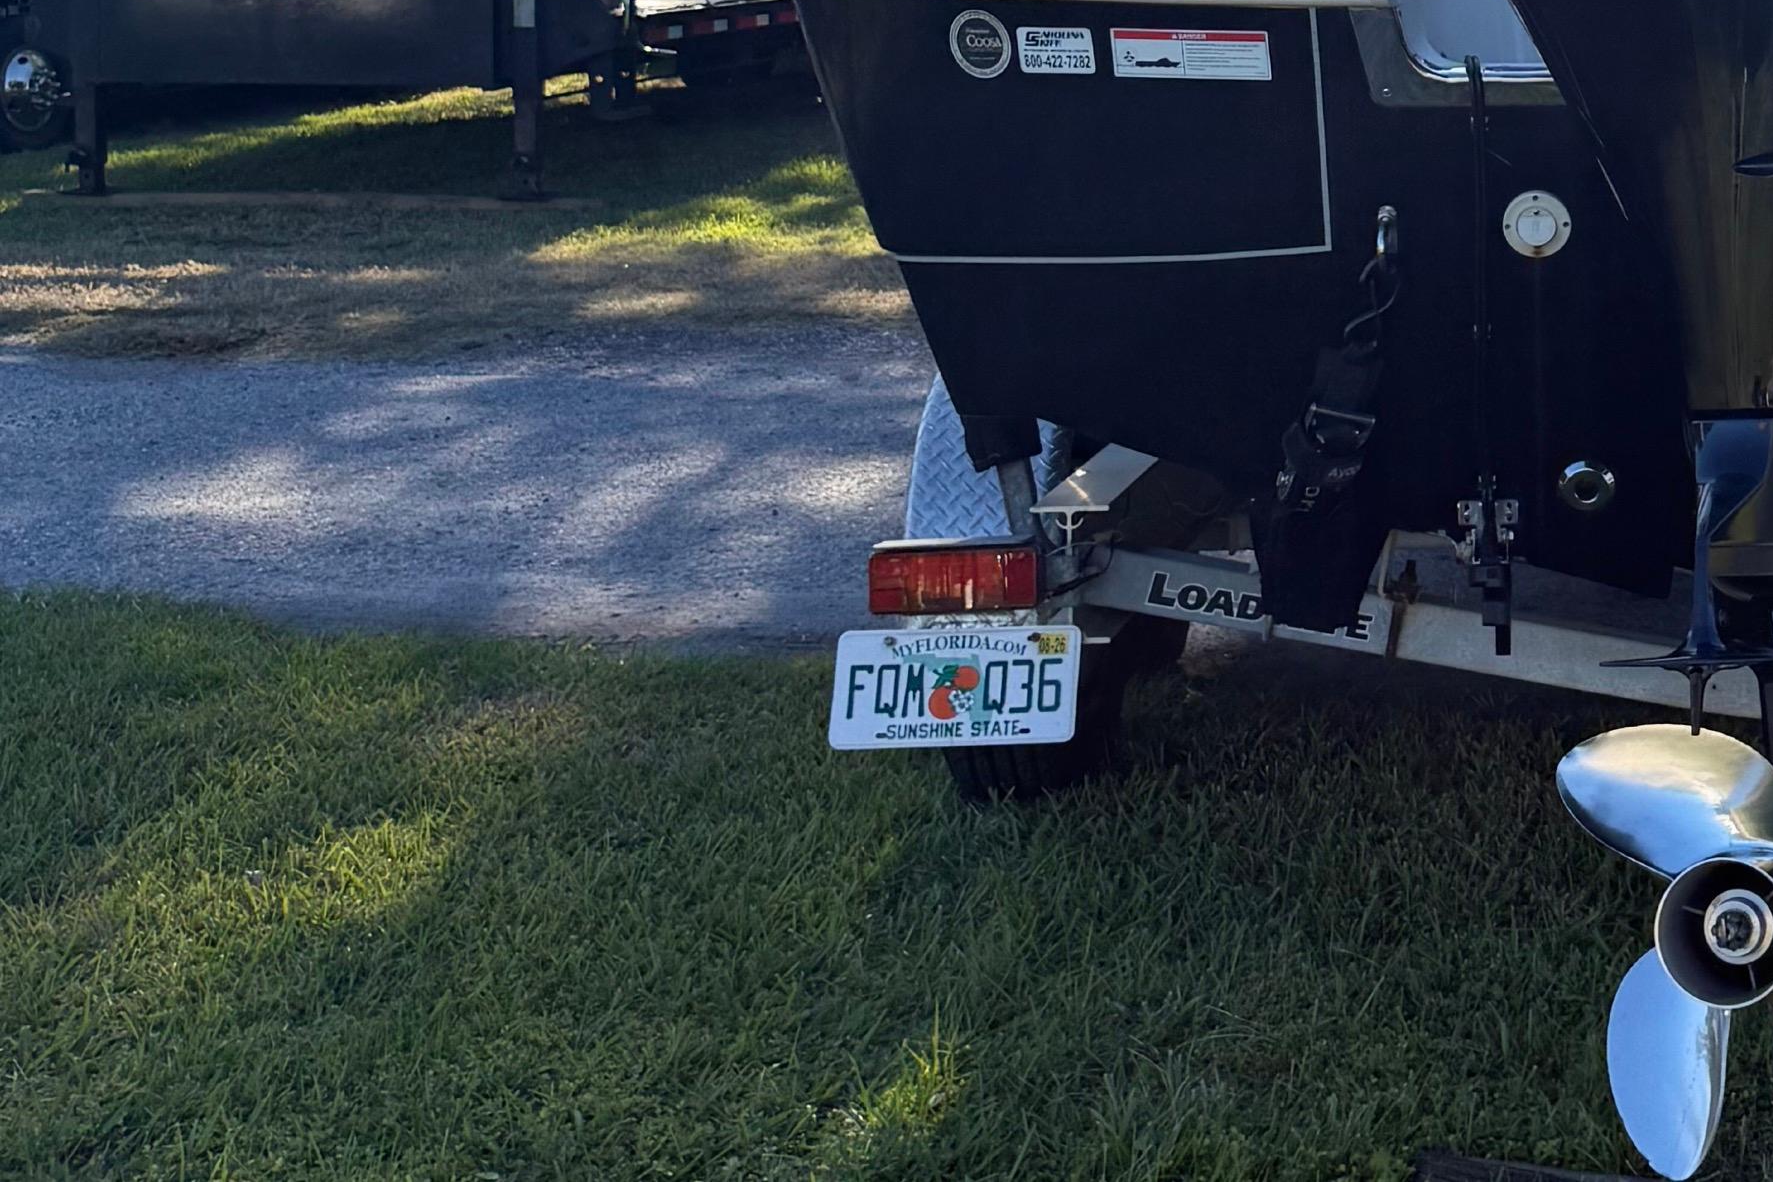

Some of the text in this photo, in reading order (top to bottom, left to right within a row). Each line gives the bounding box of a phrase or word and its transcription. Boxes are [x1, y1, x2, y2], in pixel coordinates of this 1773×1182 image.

[891, 634, 1028, 659] MYFLORIDA.COM
[846, 658, 1064, 720] FQM Q36
[886, 719, 1021, 740] SUNSHINE STATE
